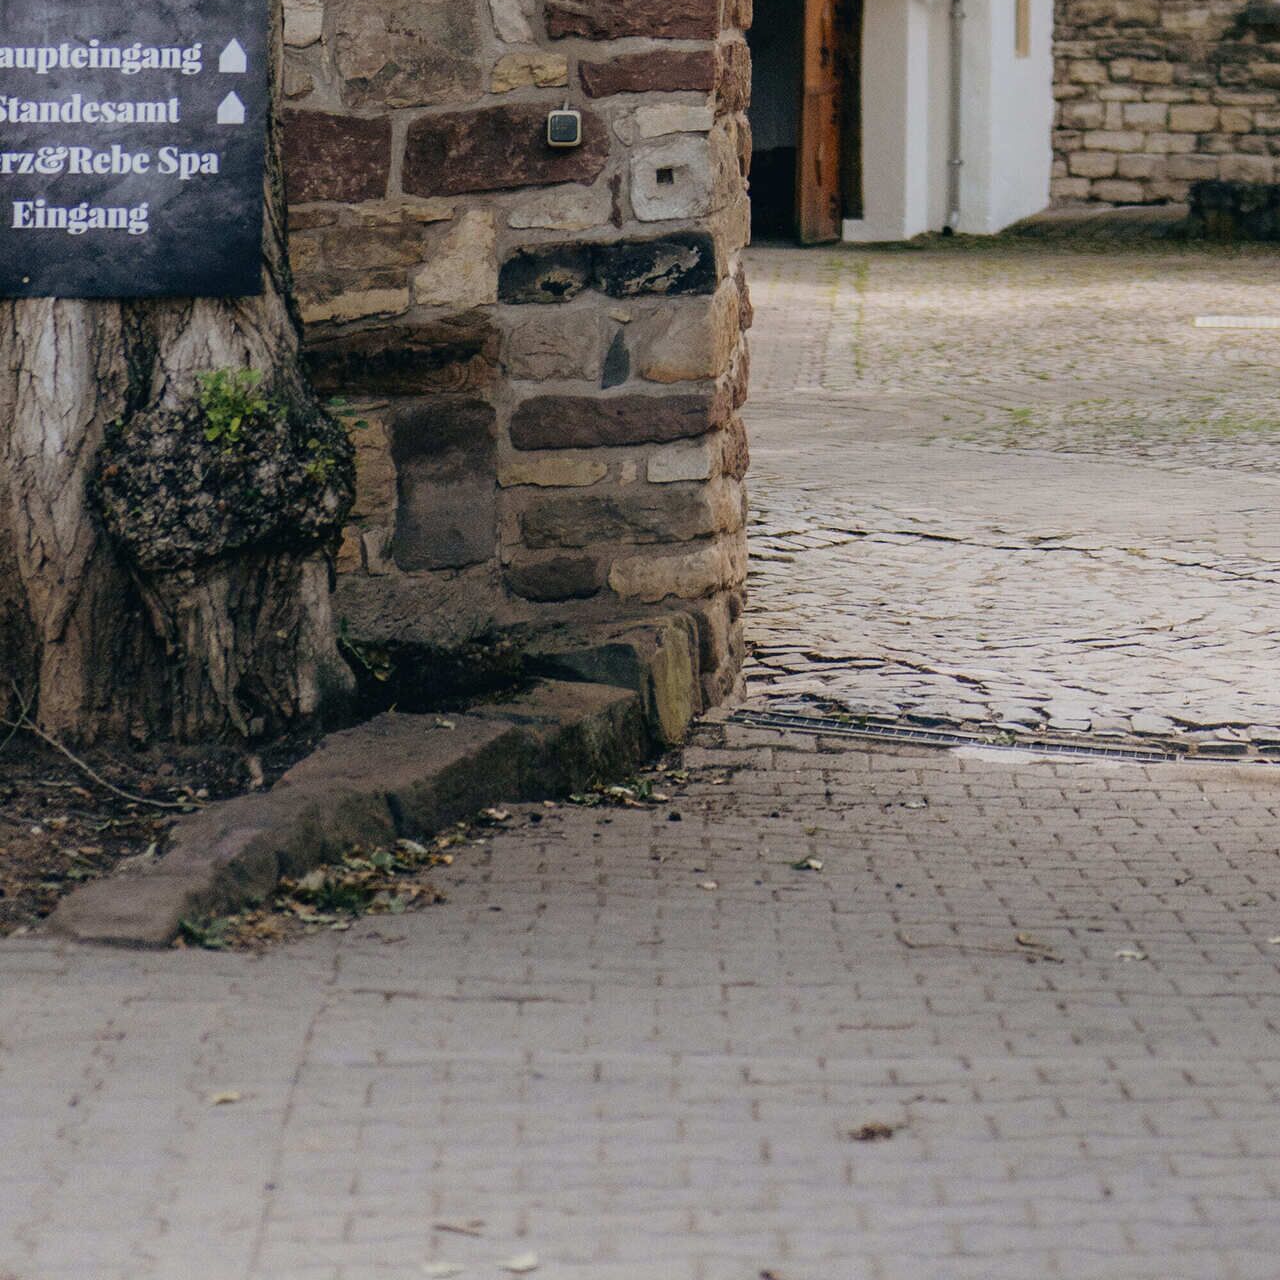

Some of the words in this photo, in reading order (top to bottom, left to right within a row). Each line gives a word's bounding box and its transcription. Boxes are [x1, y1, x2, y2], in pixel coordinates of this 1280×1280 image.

[0, 145, 150, 174] rz&Rebe
[158, 146, 219, 180] Spa
[11, 198, 149, 235] Eingang
